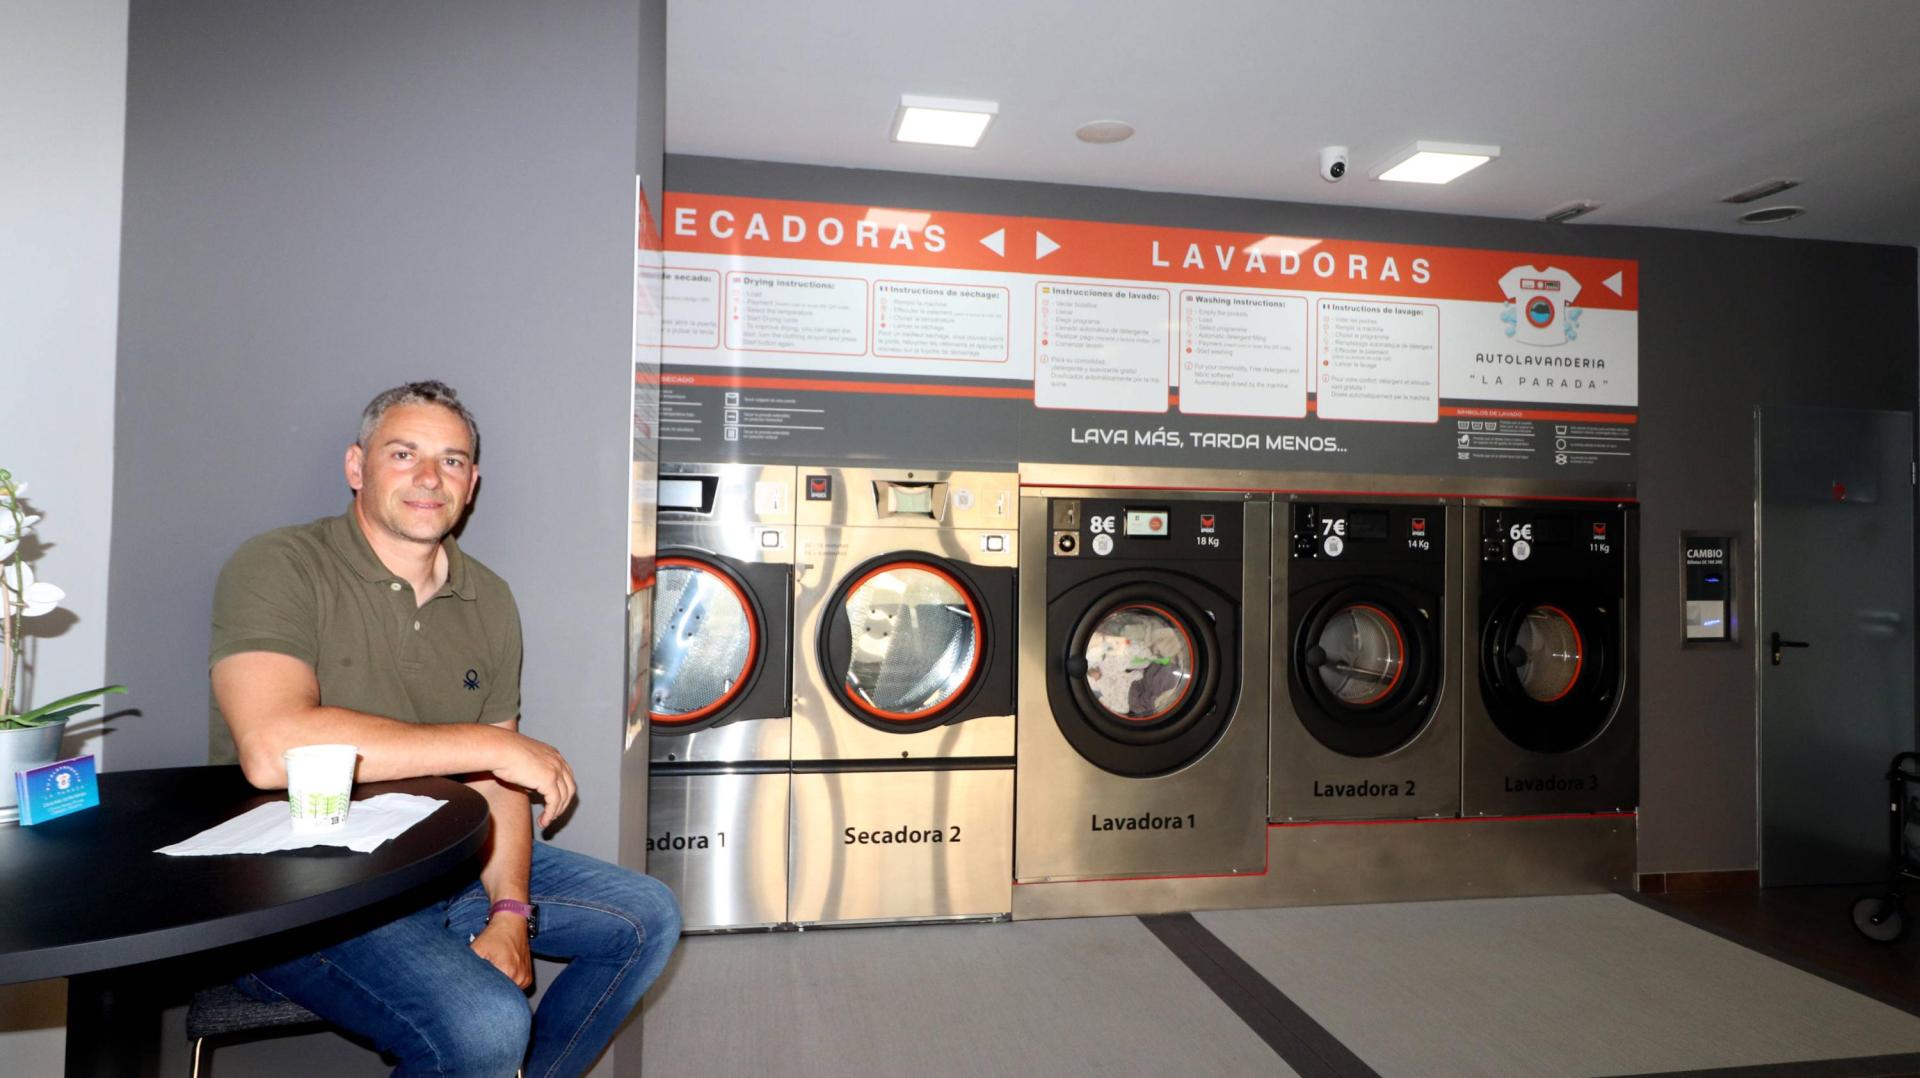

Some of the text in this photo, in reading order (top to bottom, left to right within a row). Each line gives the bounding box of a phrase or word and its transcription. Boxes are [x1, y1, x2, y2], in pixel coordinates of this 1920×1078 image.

[674, 207, 946, 252] ECADORAS
[1151, 240, 1431, 283] LAVADORAS
[743, 277, 835, 289] Drying instructions:
[891, 286, 944, 295] Instructions
[1052, 287, 1113, 298] Instrucciones
[1129, 292, 1160, 300] lavado:
[1196, 296, 1286, 307] Washing instructions:
[1332, 304, 1381, 313] Instructions
[1395, 308, 1424, 316] lavage:
[1476, 353, 1605, 369] AUTOLAVANDERIA
[1071, 425, 1348, 453] LAVA MÁS, TARDA MENOS...
[1090, 516, 1116, 533] 8€
[1322, 519, 1345, 536] 7€
[1510, 524, 1532, 540] 6€
[1196, 537, 1219, 548] 18 Kg
[1408, 540, 1429, 550] 14 Kg
[1599, 544, 1610, 553] Kg
[1687, 549, 1723, 559] CAMBIO
[1313, 780, 1415, 797] Lavadora 2
[1505, 774, 1598, 793] Lavadora 3
[1092, 812, 1195, 831] Lavadora 1
[717, 832, 725, 848] 1
[844, 825, 961, 845] Secadora 2
